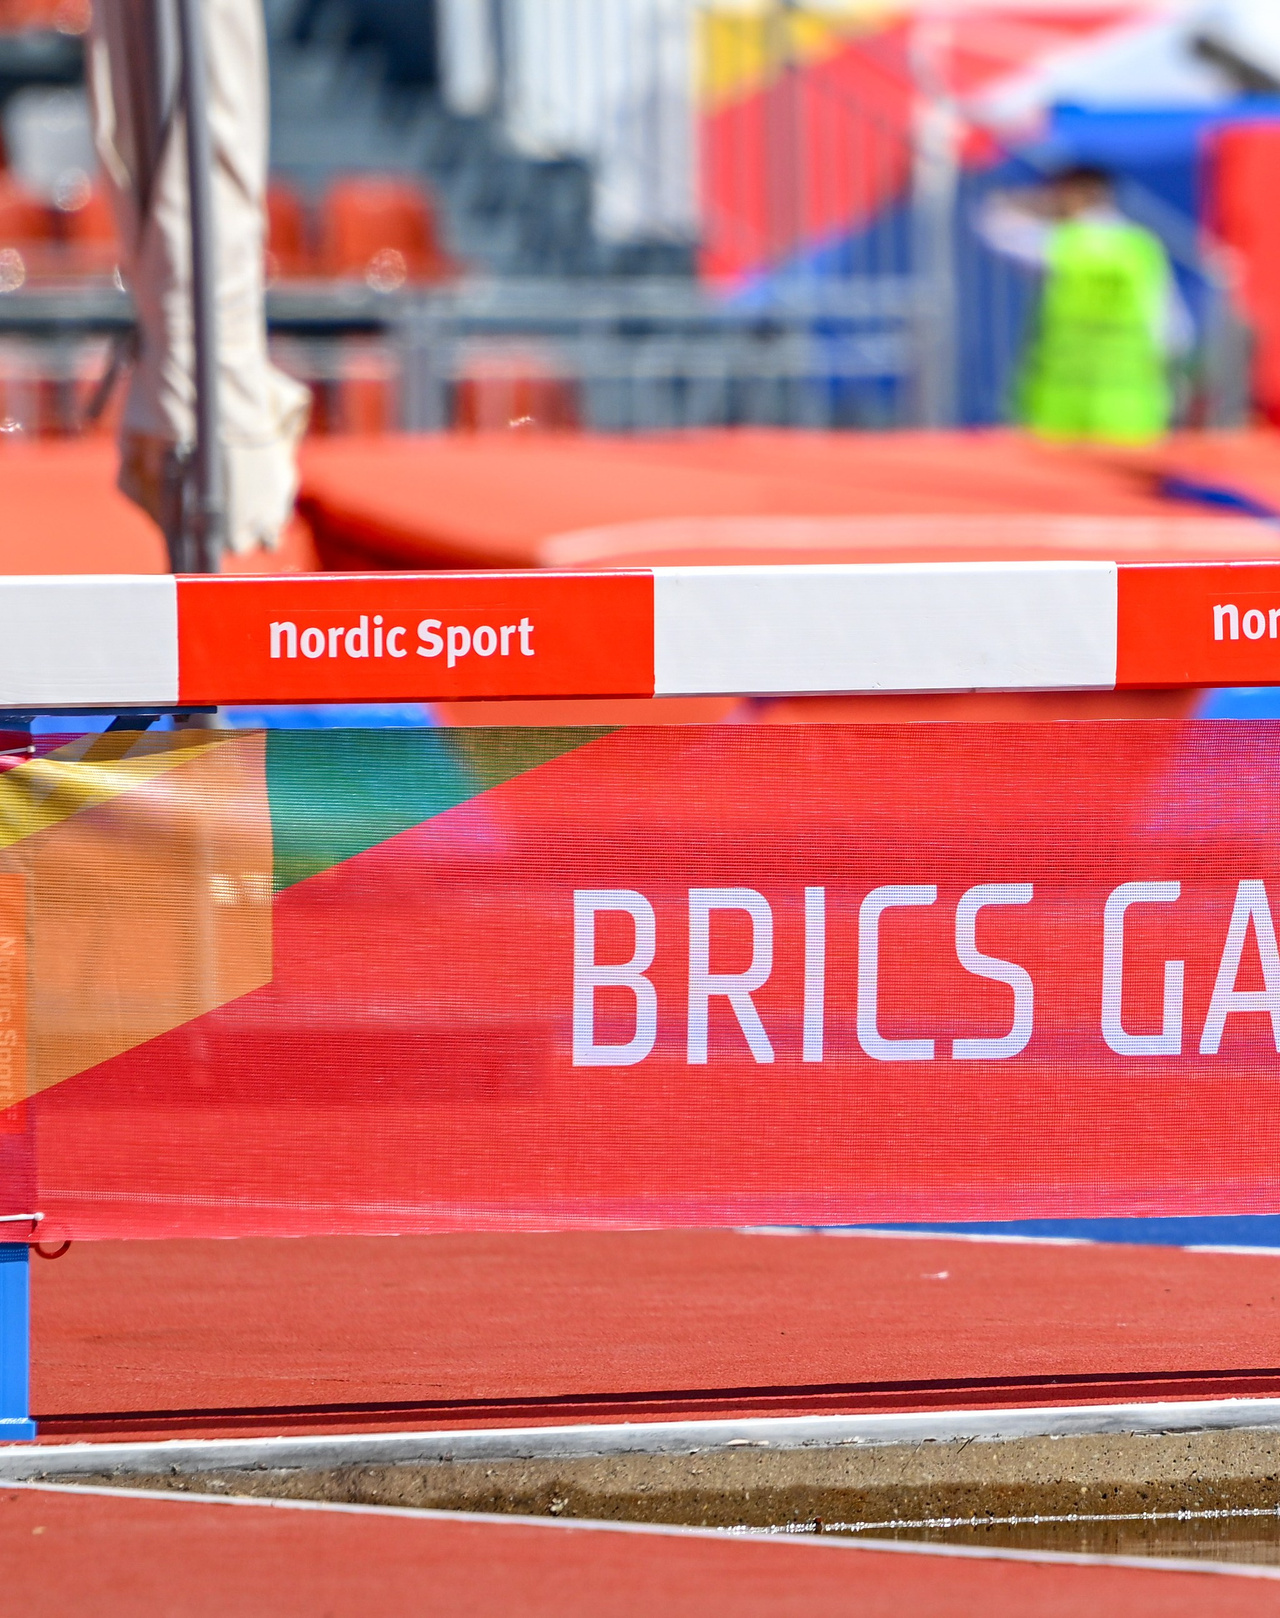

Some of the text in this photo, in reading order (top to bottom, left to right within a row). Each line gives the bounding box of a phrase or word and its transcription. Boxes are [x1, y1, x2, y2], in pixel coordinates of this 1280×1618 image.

[269, 615, 535, 669] nordic Sport
[572, 882, 1034, 1067] BRICS
